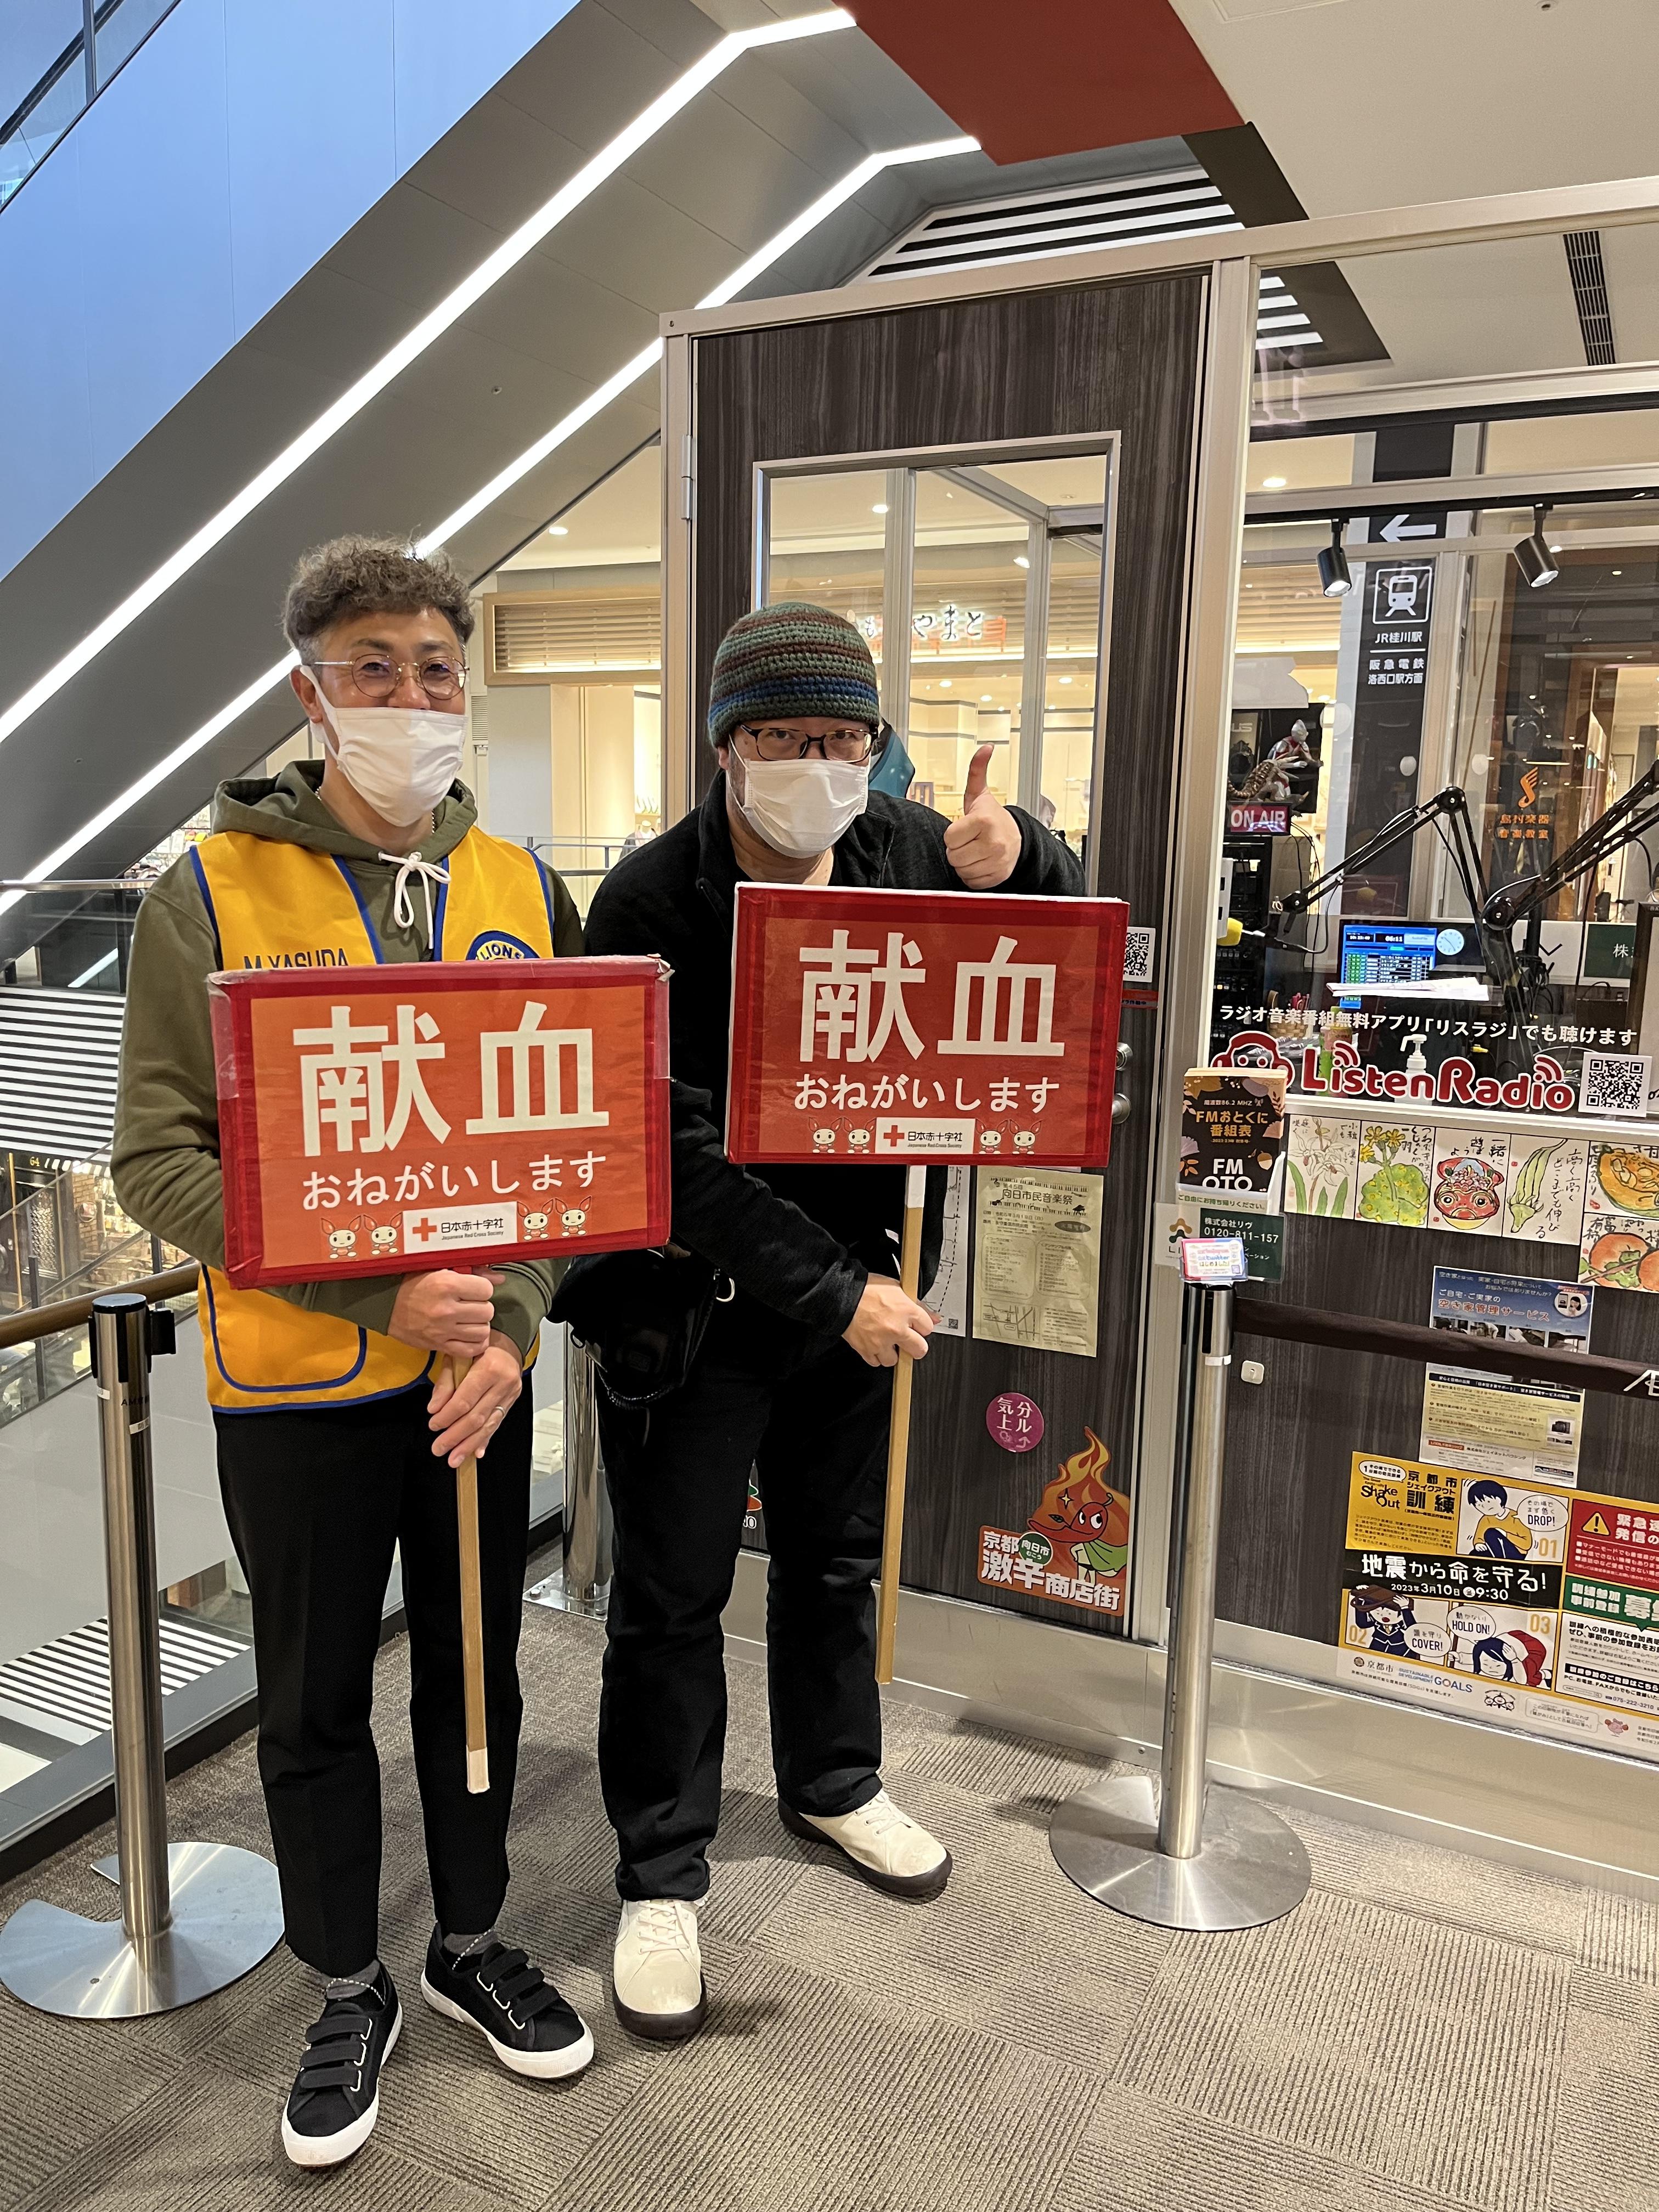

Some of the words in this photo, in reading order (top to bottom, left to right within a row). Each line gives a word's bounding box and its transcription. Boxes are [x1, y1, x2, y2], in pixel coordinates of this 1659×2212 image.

[912, 605, 981, 640] やまと
[1375, 631, 1423, 644] JR桂川駅
[1369, 658, 1425, 670] 阪急電鉄
[1368, 673, 1424, 685] 洛西口駅方面
[1231, 809, 1254, 828] ON
[1260, 810, 1286, 828] AIR
[799, 929, 1065, 1063] 献血
[1219, 1005, 1637, 1046] ラジオ音楽番組無料アプリ「リスラジ」でも聴けます
[293, 1001, 610, 1157] 献血
[794, 1073, 1060, 1113] おねがいします
[1196, 1110, 1268, 1124] FMおとくに
[908, 1131, 963, 1142] 日本赤十字社
[1210, 1124, 1251, 1137] 番組表
[30, 1156, 40, 1167] 64
[1213, 1159, 1243, 1175] FM
[302, 1150, 607, 1211] おねがいします
[1565, 1148, 1583, 1201] 高く高く
[1202, 1176, 1252, 1192] OTO
[1002, 1189, 1073, 1205] 向日市民音楽祭
[1178, 1194, 1265, 1210] ご自由にお持ち帰りください。
[441, 1217, 504, 1233] 日本赤十字社
[1204, 1217, 1253, 1229] 株式会社リヴ
[1204, 1227, 1279, 1244] 0120-811-157
[1438, 1299, 1550, 1322] 空き家管理サービス
[1408, 1470, 1458, 1488] 京都市
[1361, 1485, 1398, 1498] Shake
[1407, 1481, 1457, 1496] シェイクアウト
[1376, 1495, 1401, 1510] Out
[1407, 1489, 1455, 1515] 訓練
[1527, 1514, 1555, 1527] DROP!
[983, 1531, 1020, 1554] 京都
[1021, 1539, 1051, 1556] 向日市
[1538, 1538, 1557, 1559] 01
[1026, 1551, 1042, 1560] むこう
[981, 1549, 1120, 1611] 激辛商店街
[1362, 1554, 1547, 1592] 地震から命を守る!
[1452, 1620, 1474, 1633] HOLD
[1476, 1623, 1490, 1635] ON!
[1529, 1613, 1550, 1635] 03
[1349, 1624, 1367, 1645] 02
[1412, 1638, 1443, 1651] COVER!
[1367, 1660, 1394, 1673] 京都市
[1434, 1676, 1473, 1693] GOALS
[1612, 1696, 1655, 1710] 075-222-3210
